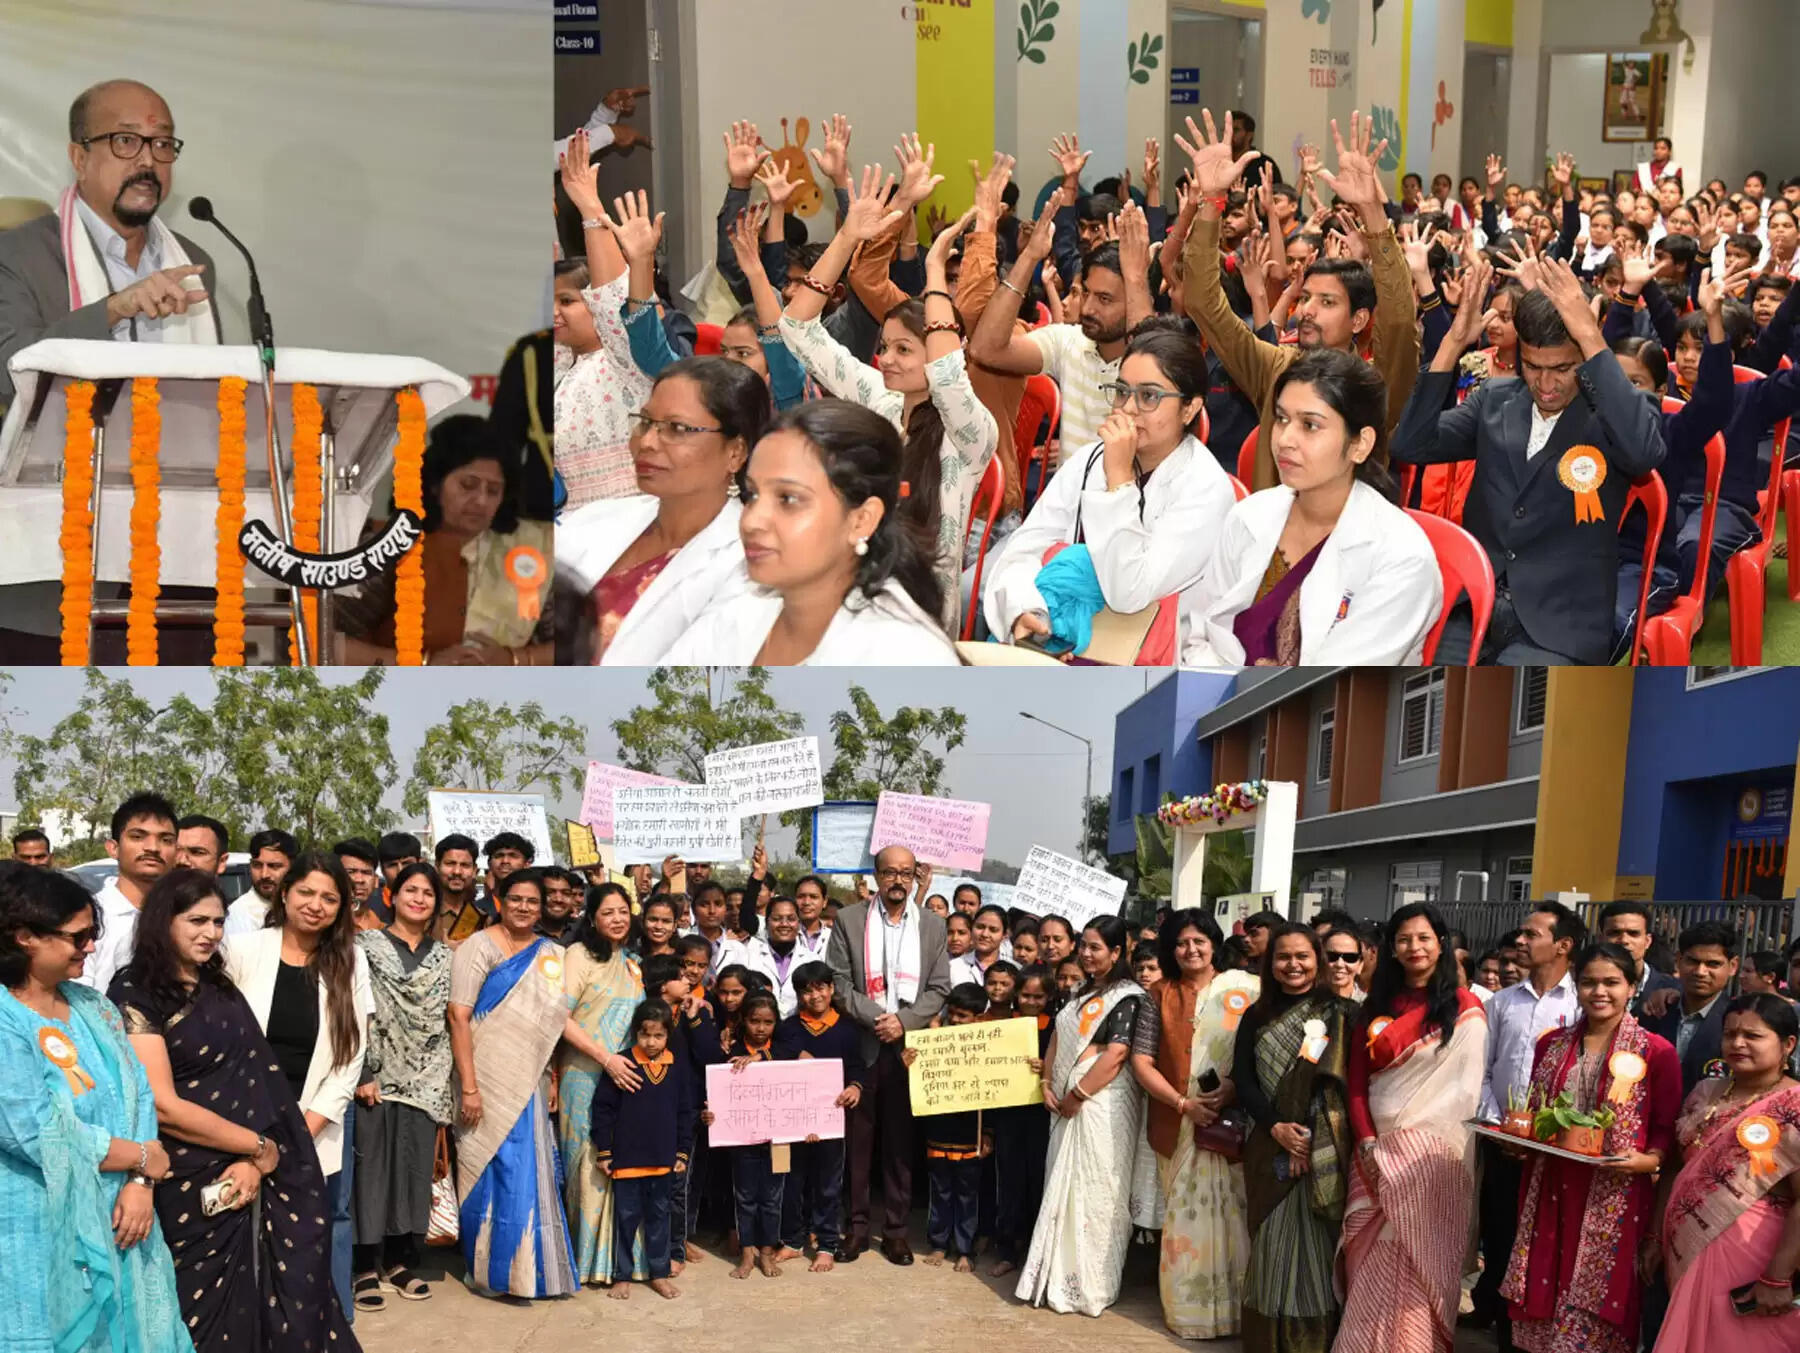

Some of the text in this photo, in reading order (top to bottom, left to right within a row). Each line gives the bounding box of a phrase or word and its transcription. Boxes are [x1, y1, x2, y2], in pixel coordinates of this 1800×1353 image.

[242, 512, 420, 587] मनीष साउण्ड रायपुर
